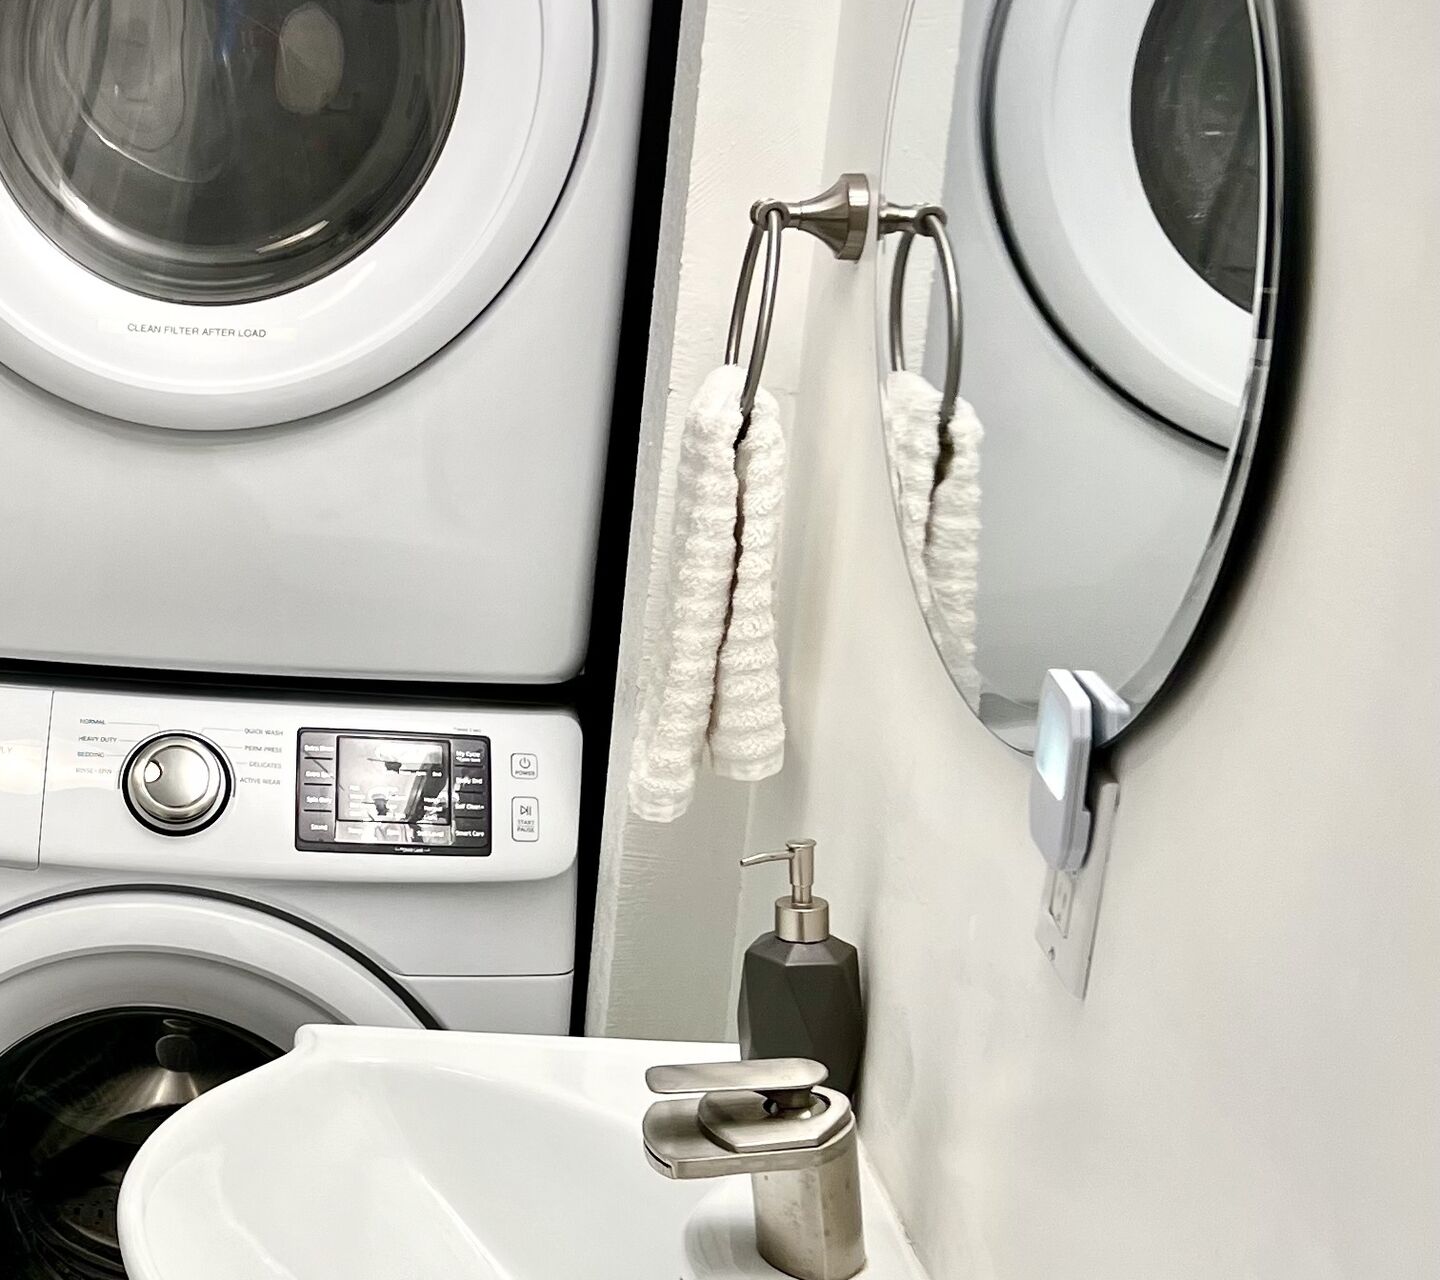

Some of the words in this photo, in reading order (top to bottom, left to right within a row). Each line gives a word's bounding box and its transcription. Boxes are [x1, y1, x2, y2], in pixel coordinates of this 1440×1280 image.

[127, 323, 161, 333] CLEAN
[164, 325, 199, 336] FILTER
[202, 327, 235, 337] AFTER
[238, 328, 266, 338] LOAD
